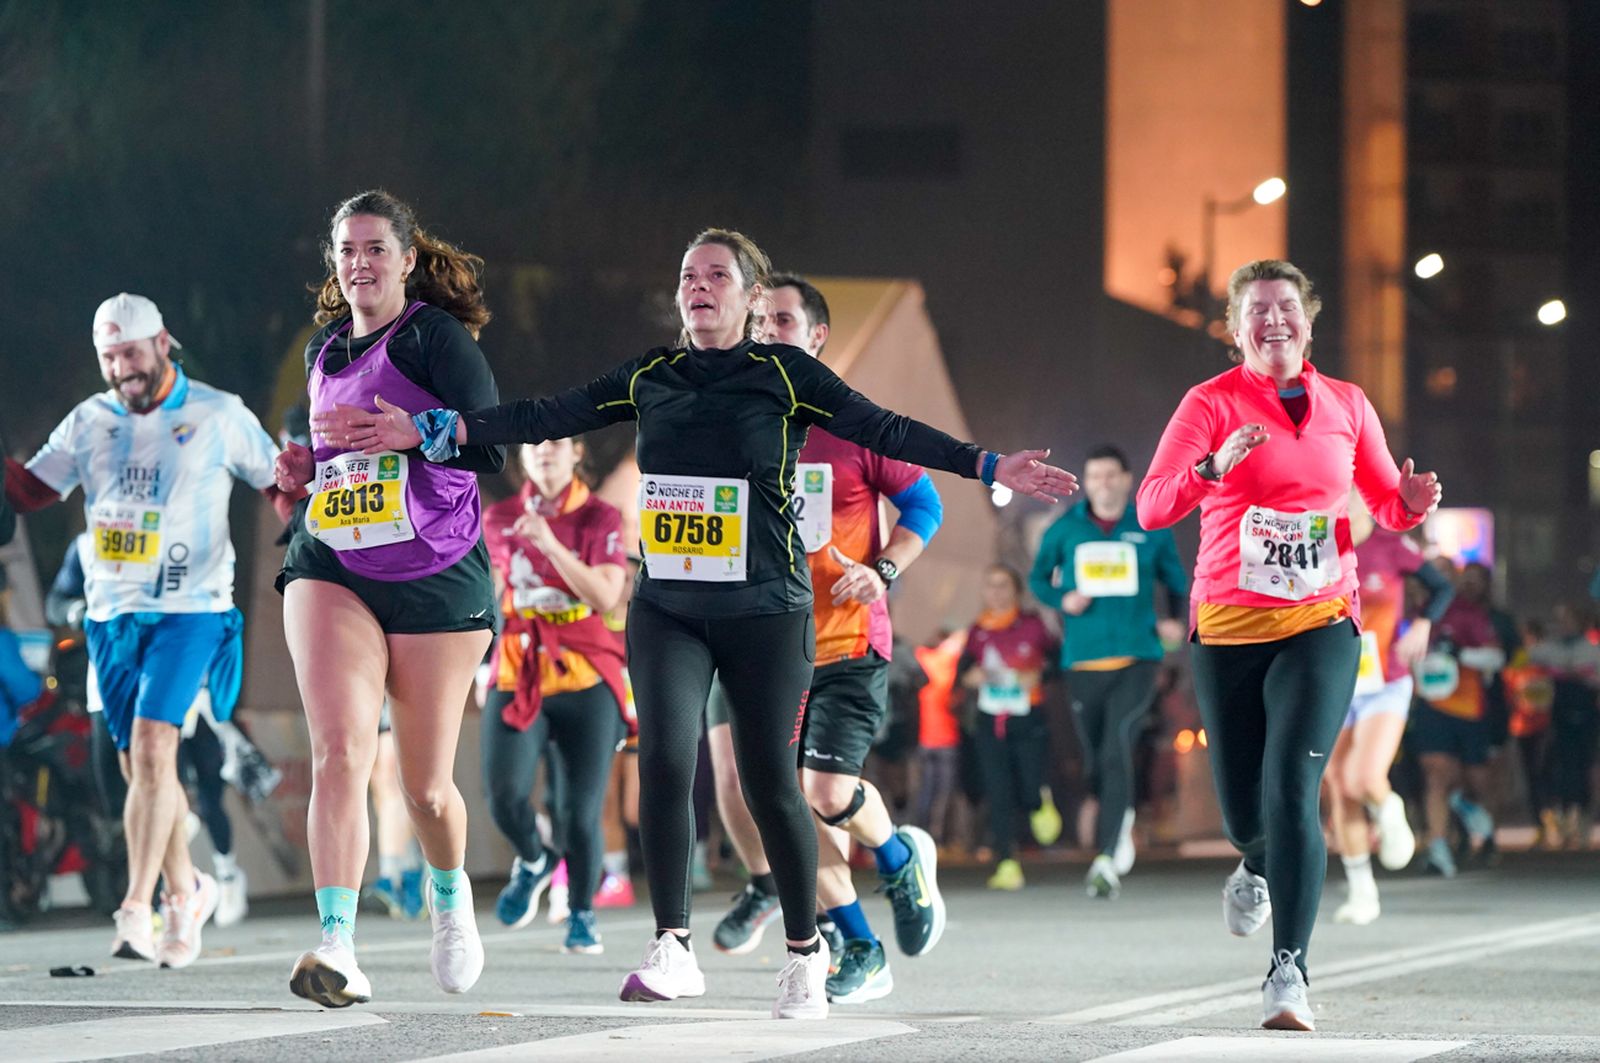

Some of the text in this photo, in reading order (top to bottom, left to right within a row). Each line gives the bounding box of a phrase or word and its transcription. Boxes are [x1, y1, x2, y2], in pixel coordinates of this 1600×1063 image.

[356, 461, 370, 472] DE
[658, 487, 705, 499] NOCHE DE
[324, 483, 385, 518] 5913
[646, 499, 667, 510] SAN
[668, 499, 705, 512] ANTÓN
[655, 513, 723, 546] 6758
[1251, 527, 1272, 538] SAN
[102, 530, 147, 555] 5981
[672, 546, 704, 556] ROSARIO
[1263, 539, 1319, 570] 2841
